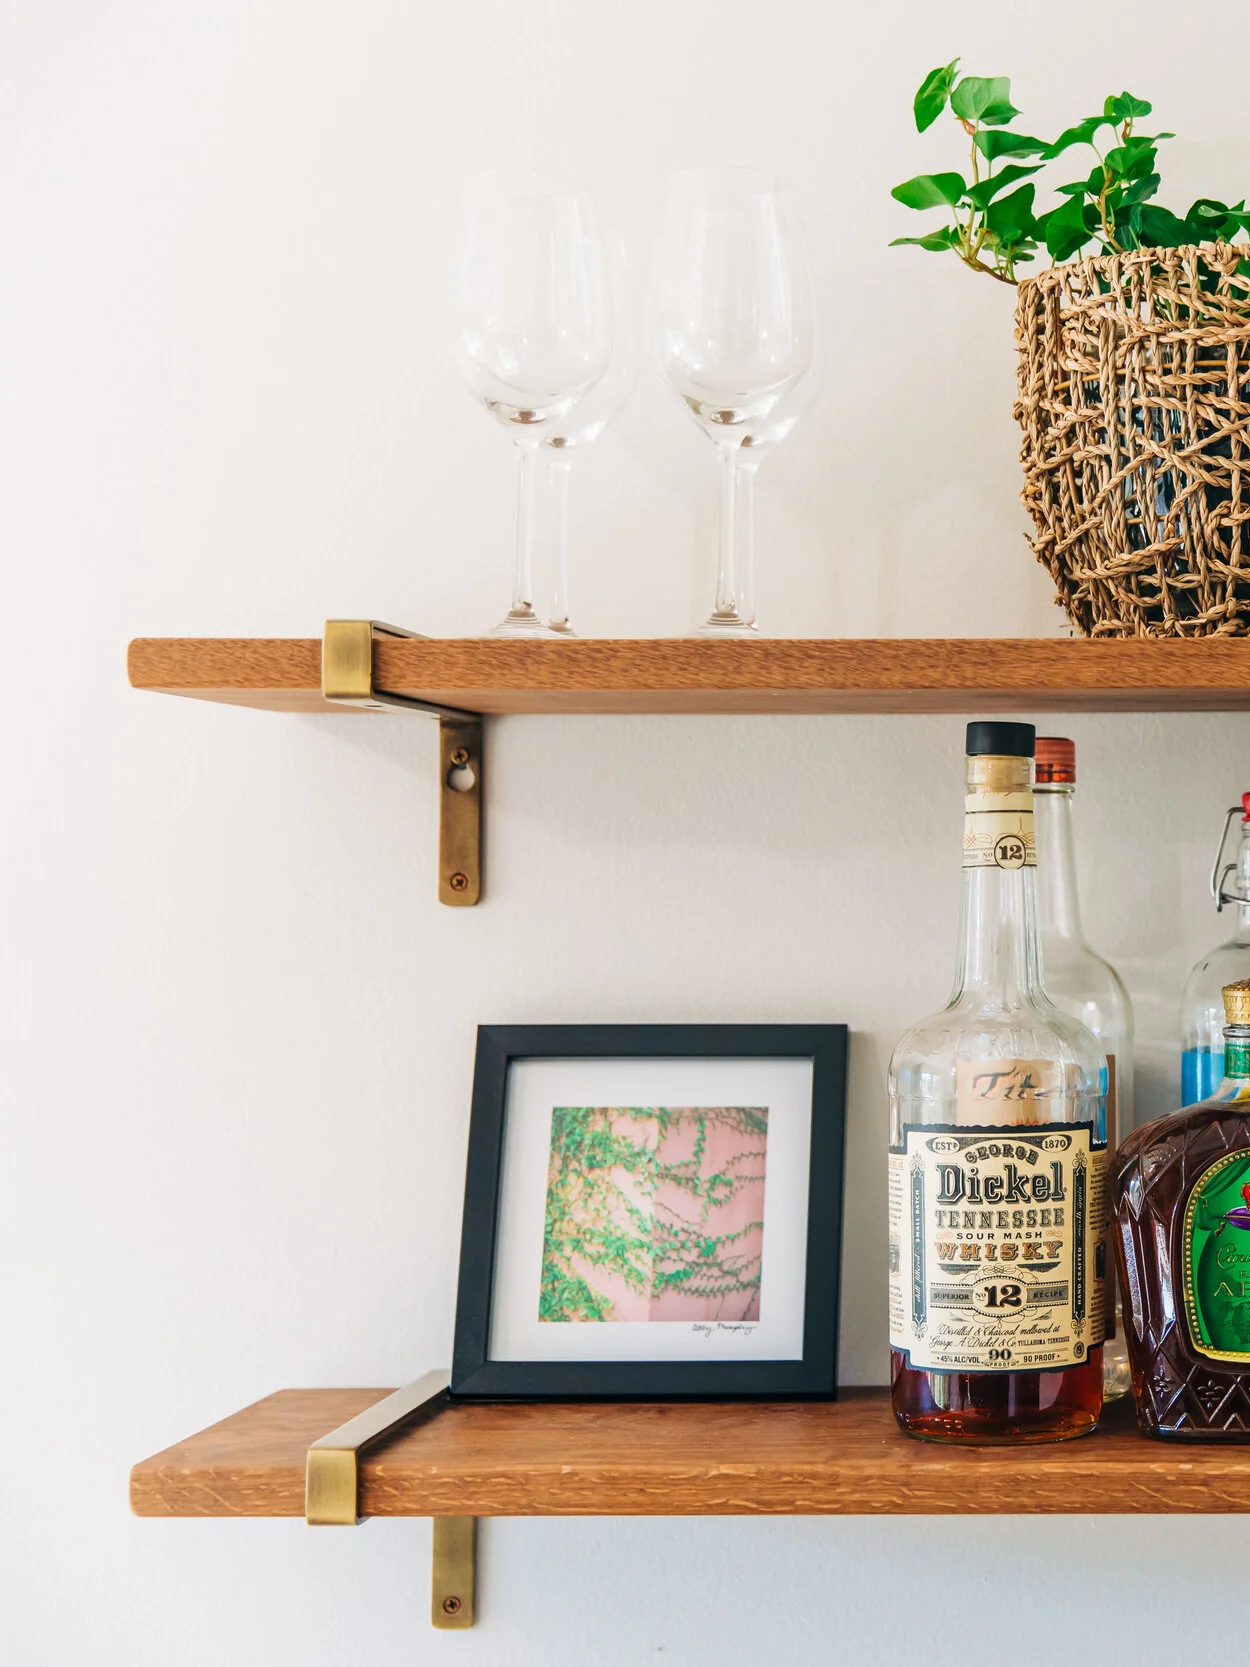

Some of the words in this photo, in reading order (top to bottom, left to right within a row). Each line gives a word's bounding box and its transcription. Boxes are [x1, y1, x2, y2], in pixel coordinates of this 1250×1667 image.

[998, 845, 1023, 860] 12
[1044, 1139, 1067, 1149] 1870
[964, 1143, 1039, 1166] GEORGE
[935, 1160, 1066, 1206] Dickel
[934, 1207, 1065, 1229] TENNESSEE
[956, 1232, 995, 1240] SOUR
[1003, 1231, 1043, 1239] MASH
[934, 1240, 1064, 1262] WHISKY
[933, 1292, 970, 1300] SUPERIOR
[984, 1284, 1023, 1308] 12
[1033, 1290, 1064, 1298] RECIPE
[938, 1323, 974, 1336] Distilled
[983, 1324, 1020, 1336] Charcoal
[1020, 1322, 1054, 1335] mellowed
[929, 1335, 953, 1351] George
[967, 1336, 1000, 1348] Dickel
[940, 1355, 953, 1363] 45%
[988, 1348, 1012, 1361] 90
[1023, 1355, 1033, 1363] 90
[1034, 1353, 1056, 1362] PROOF
